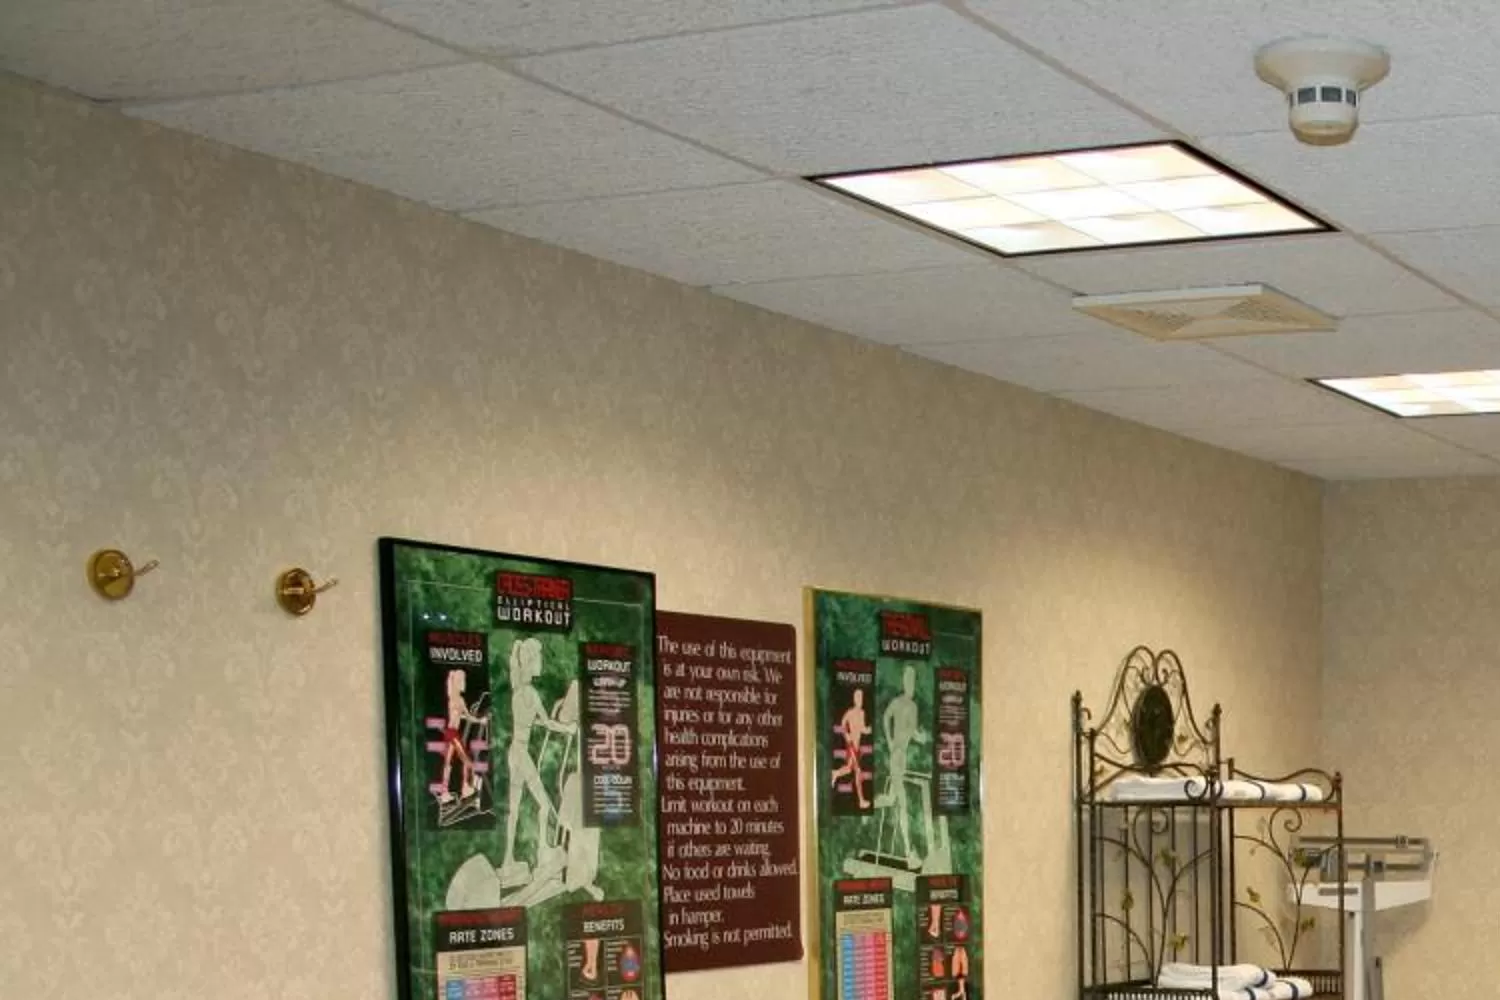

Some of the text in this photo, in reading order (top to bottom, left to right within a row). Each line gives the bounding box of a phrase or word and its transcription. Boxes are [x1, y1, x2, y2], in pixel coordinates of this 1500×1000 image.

[497, 607, 571, 627] WORKOUT
[429, 647, 482, 663] INVOLVED
[657, 635, 792, 667] The use of this equipment
[882, 639, 930, 655] WORKOUT
[587, 659, 631, 673] WORKOUT
[663, 660, 673, 677] is
[675, 663, 686, 677] at
[689, 664, 713, 681] your
[716, 667, 740, 680] own
[764, 667, 783, 684] We
[663, 684, 779, 709] are not responsible for
[703, 711, 715, 723] or
[718, 709, 732, 724] for
[735, 713, 753, 730] any
[757, 708, 783, 726] other
[590, 722, 631, 765] 20
[663, 726, 769, 752] health complications
[665, 750, 781, 773] arising from the use of
[666, 773, 685, 790] this
[661, 796, 779, 813] Limit workout on each
[667, 817, 785, 836] machine to 20 minutes
[667, 840, 675, 858] if
[678, 839, 712, 858] others
[714, 844, 731, 857] are
[662, 864, 681, 880] No
[684, 861, 710, 880] food
[712, 867, 724, 879] or
[727, 860, 757, 878] drinks
[663, 880, 756, 903] Place used towels
[583, 918, 625, 933] BENEFITS
[669, 910, 679, 925] in
[449, 928, 514, 944] RATE ZONES
[664, 928, 709, 950] Smoking
[711, 931, 721, 944] is
[723, 927, 741, 943] not
